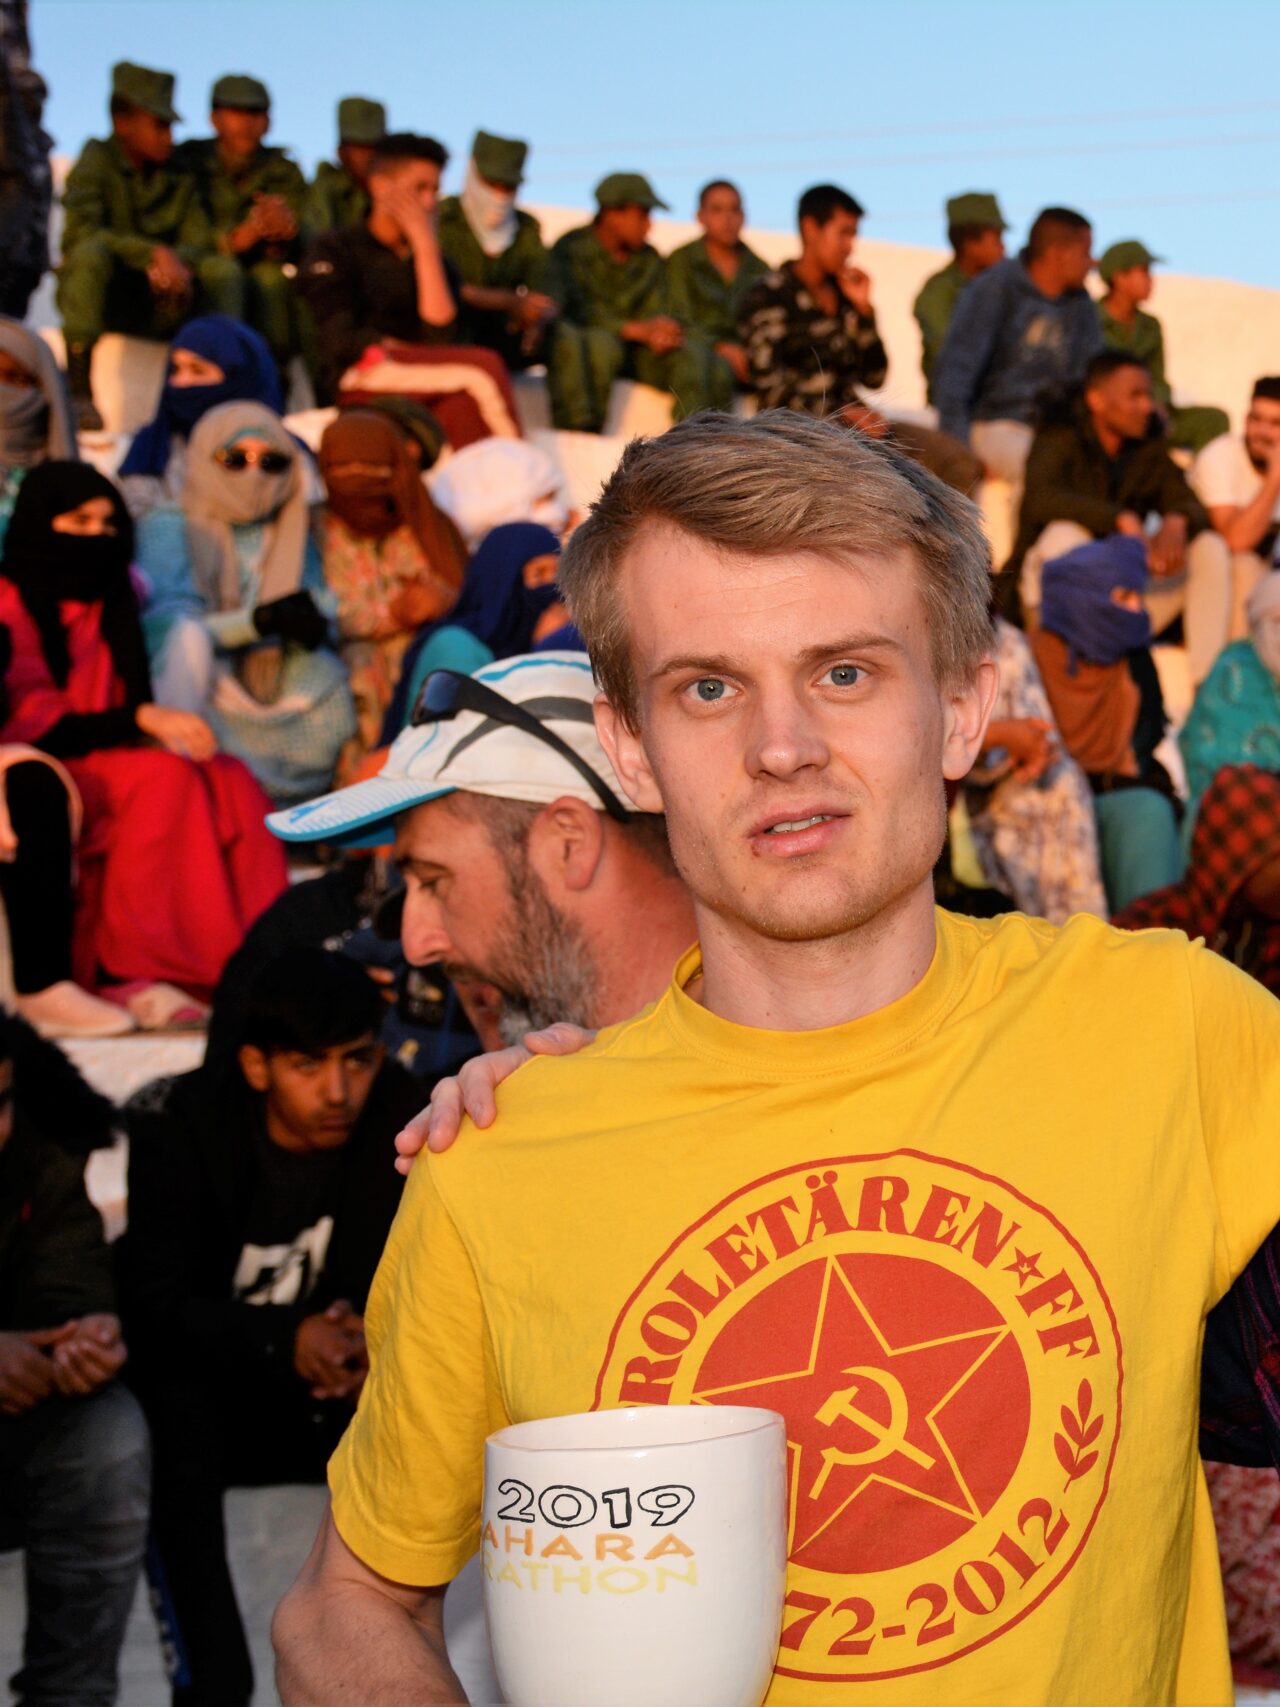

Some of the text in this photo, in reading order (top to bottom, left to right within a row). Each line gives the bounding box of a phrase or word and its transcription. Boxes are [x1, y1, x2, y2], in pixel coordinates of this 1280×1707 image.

[618, 1170, 1100, 1407] ROLETÄREN FF
[498, 1479, 695, 1528] 2019
[483, 1520, 695, 1561] AHARA
